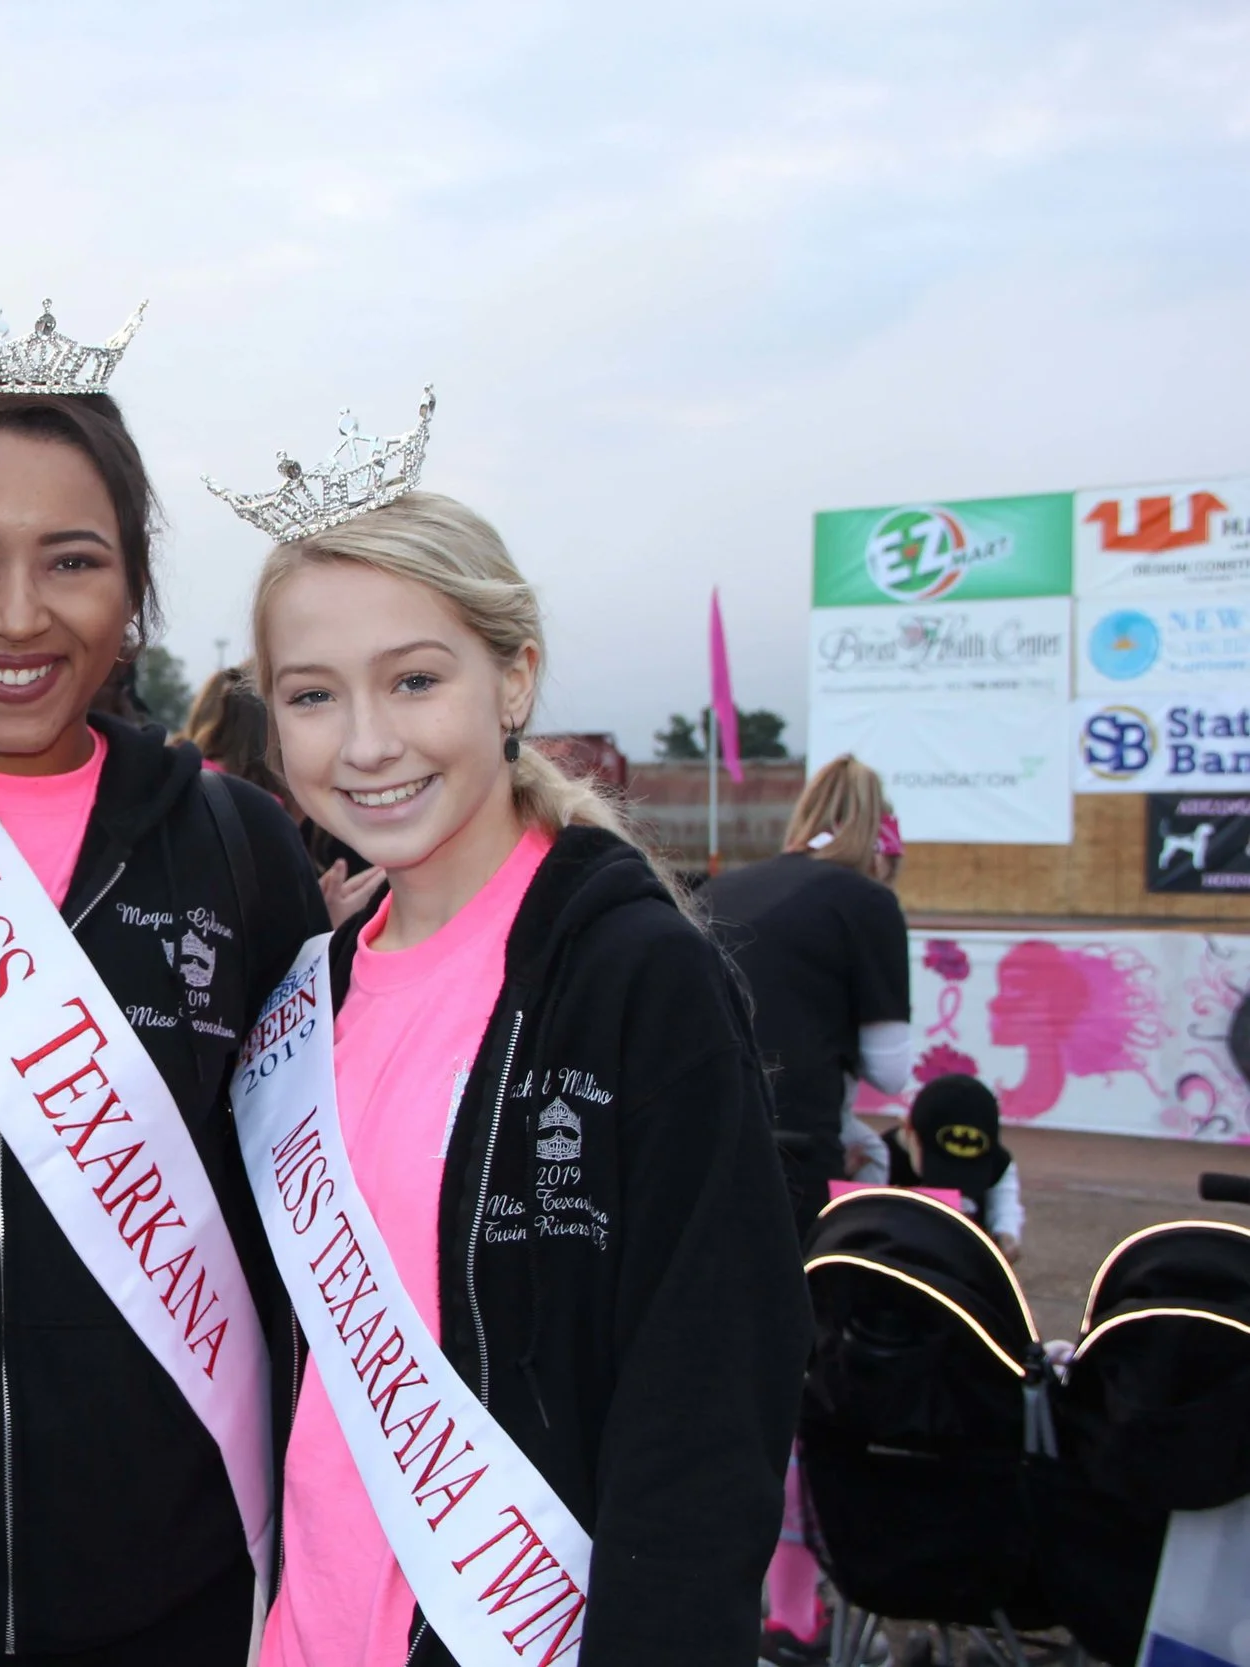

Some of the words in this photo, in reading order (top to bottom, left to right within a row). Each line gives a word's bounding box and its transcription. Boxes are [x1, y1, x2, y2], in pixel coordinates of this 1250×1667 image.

[116, 903, 183, 931] Mega
[185, 989, 211, 1008] 019
[126, 1005, 178, 1028] Miss
[241, 1018, 316, 1097] 2019
[535, 1165, 582, 1187] 2019
[10, 996, 231, 1381] TEXARKANA
[485, 1194, 527, 1217] Mis
[484, 1221, 528, 1243] Twin
[272, 1105, 336, 1236] MISS
[309, 1211, 491, 1534] TEXARKANA
[451, 1505, 587, 1667] TWIN
